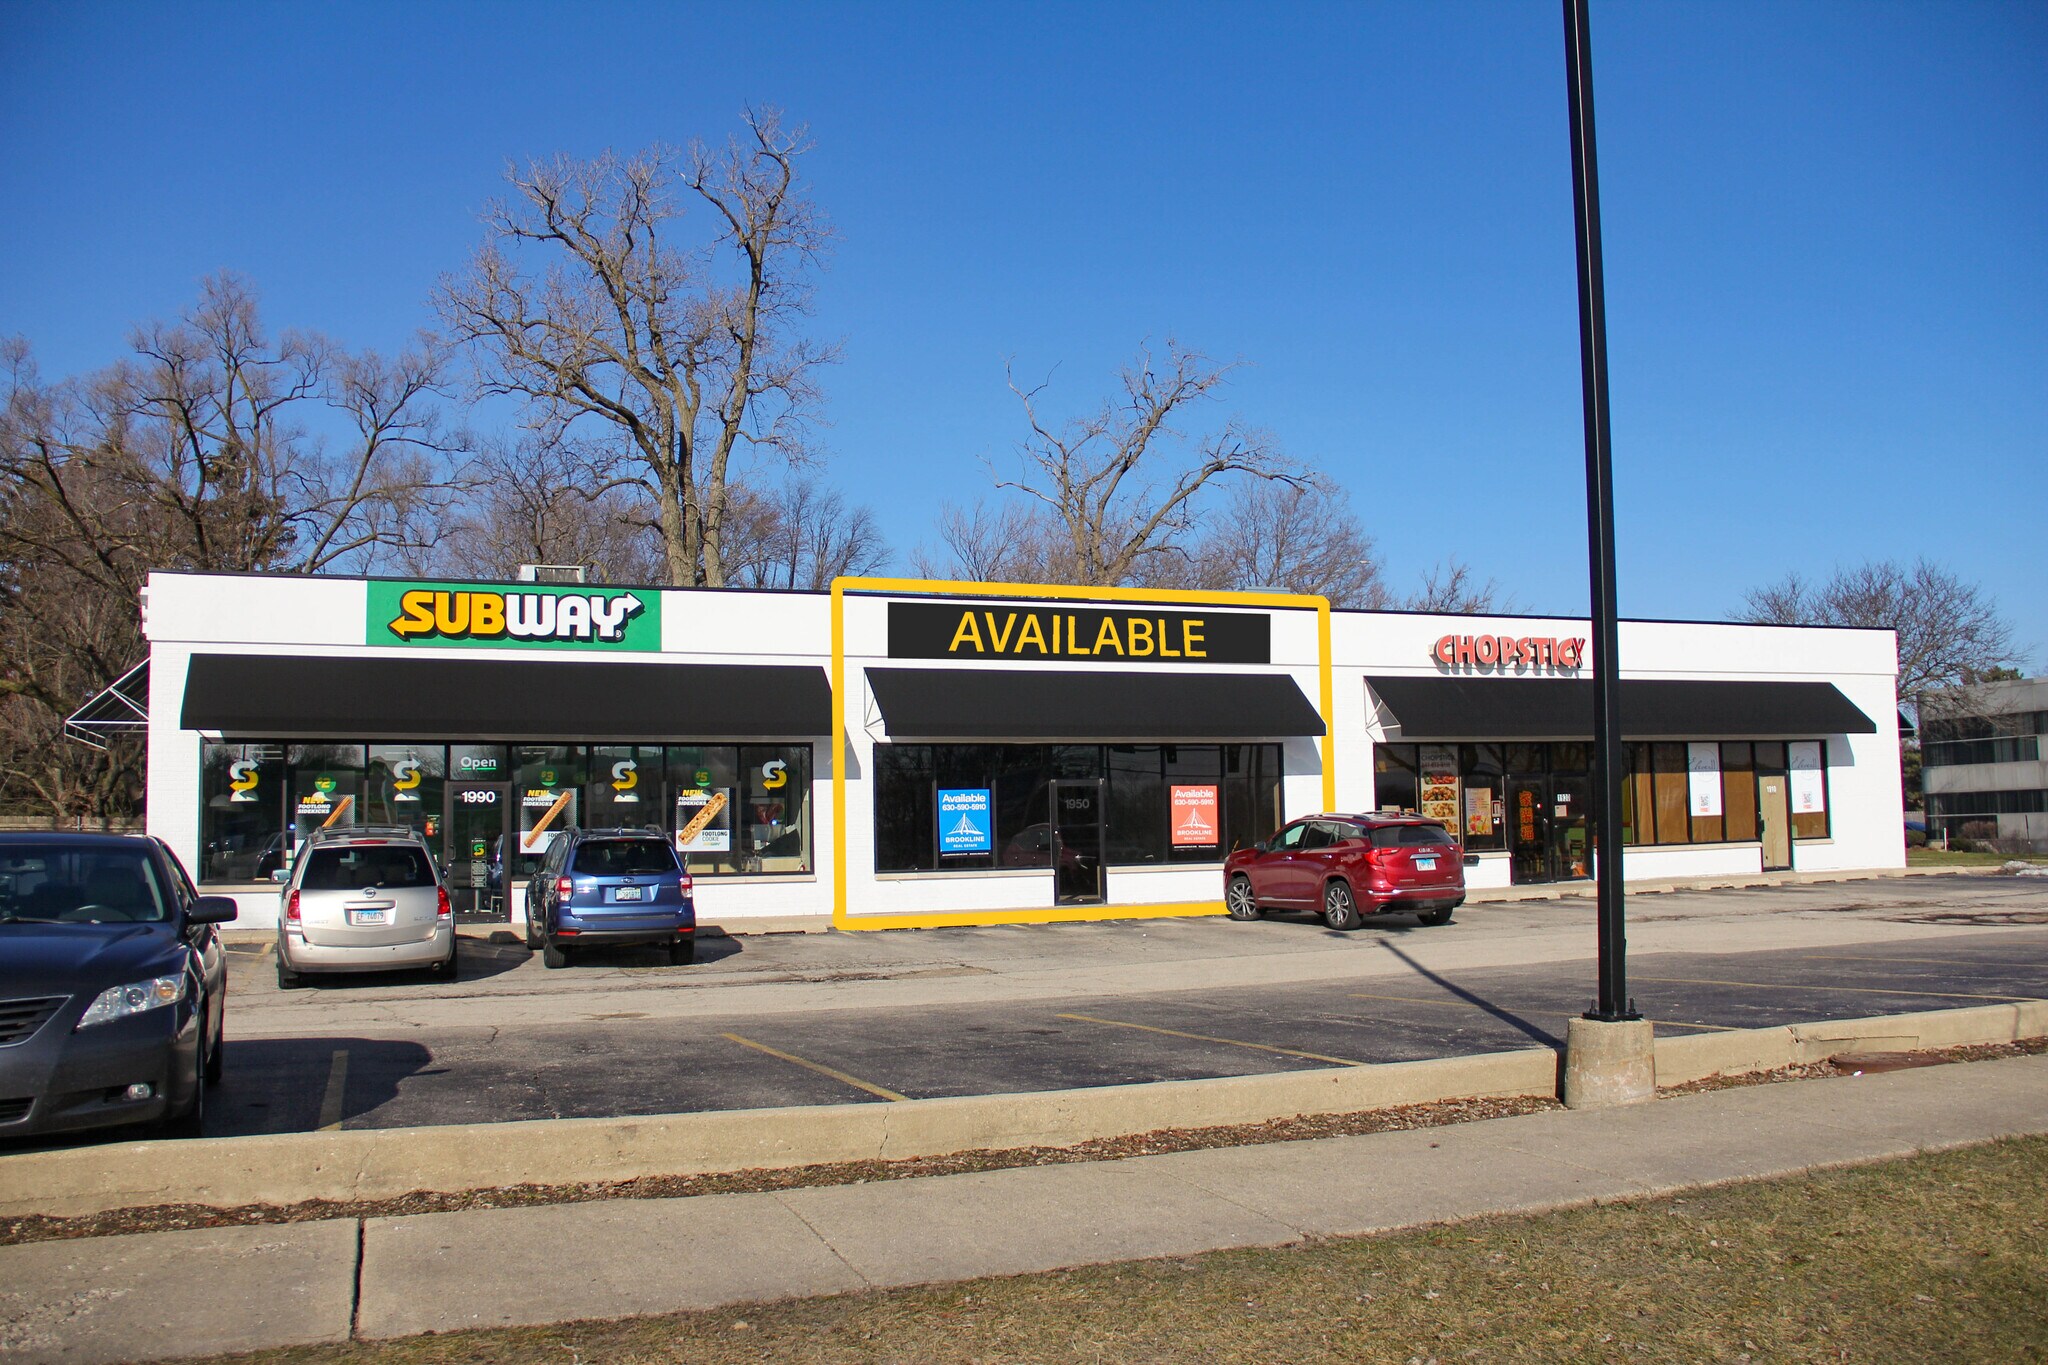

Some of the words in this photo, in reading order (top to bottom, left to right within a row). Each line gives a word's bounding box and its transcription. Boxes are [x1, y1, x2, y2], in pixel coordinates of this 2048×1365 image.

[460, 756, 497, 770] Open
[541, 771, 554, 781] $3
[696, 771, 708, 782] $5
[461, 791, 496, 803] 1990
[942, 793, 986, 803] Available
[1174, 790, 1214, 798] Available
[302, 796, 326, 804] NEW
[1065, 798, 1090, 809] 1950
